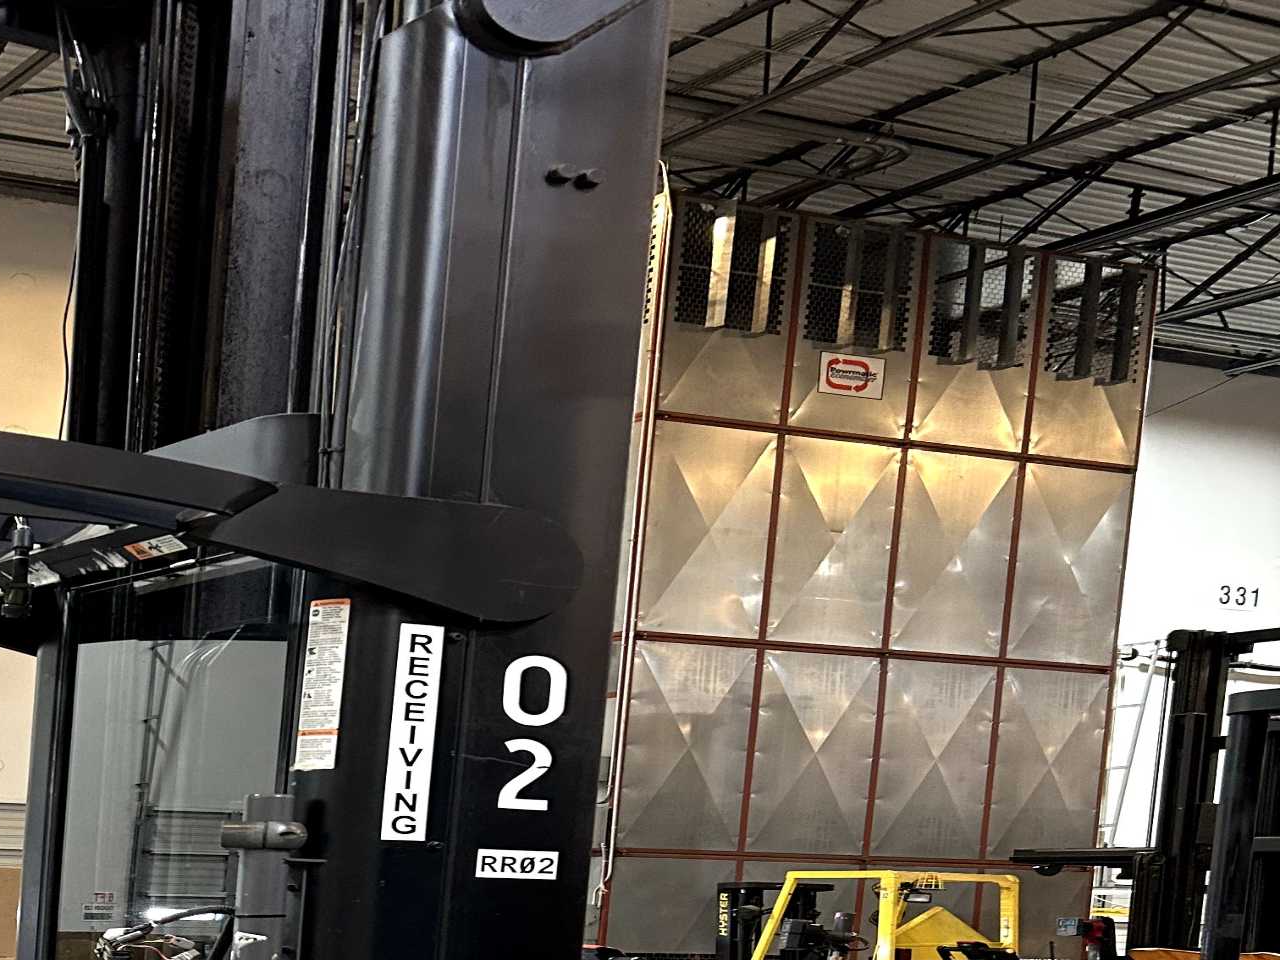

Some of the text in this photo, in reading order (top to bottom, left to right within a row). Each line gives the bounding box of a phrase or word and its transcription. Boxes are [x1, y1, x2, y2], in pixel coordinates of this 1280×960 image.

[1219, 585, 1260, 607] 331
[391, 633, 433, 835] RECEIVING
[718, 892, 729, 937] HYSTER
